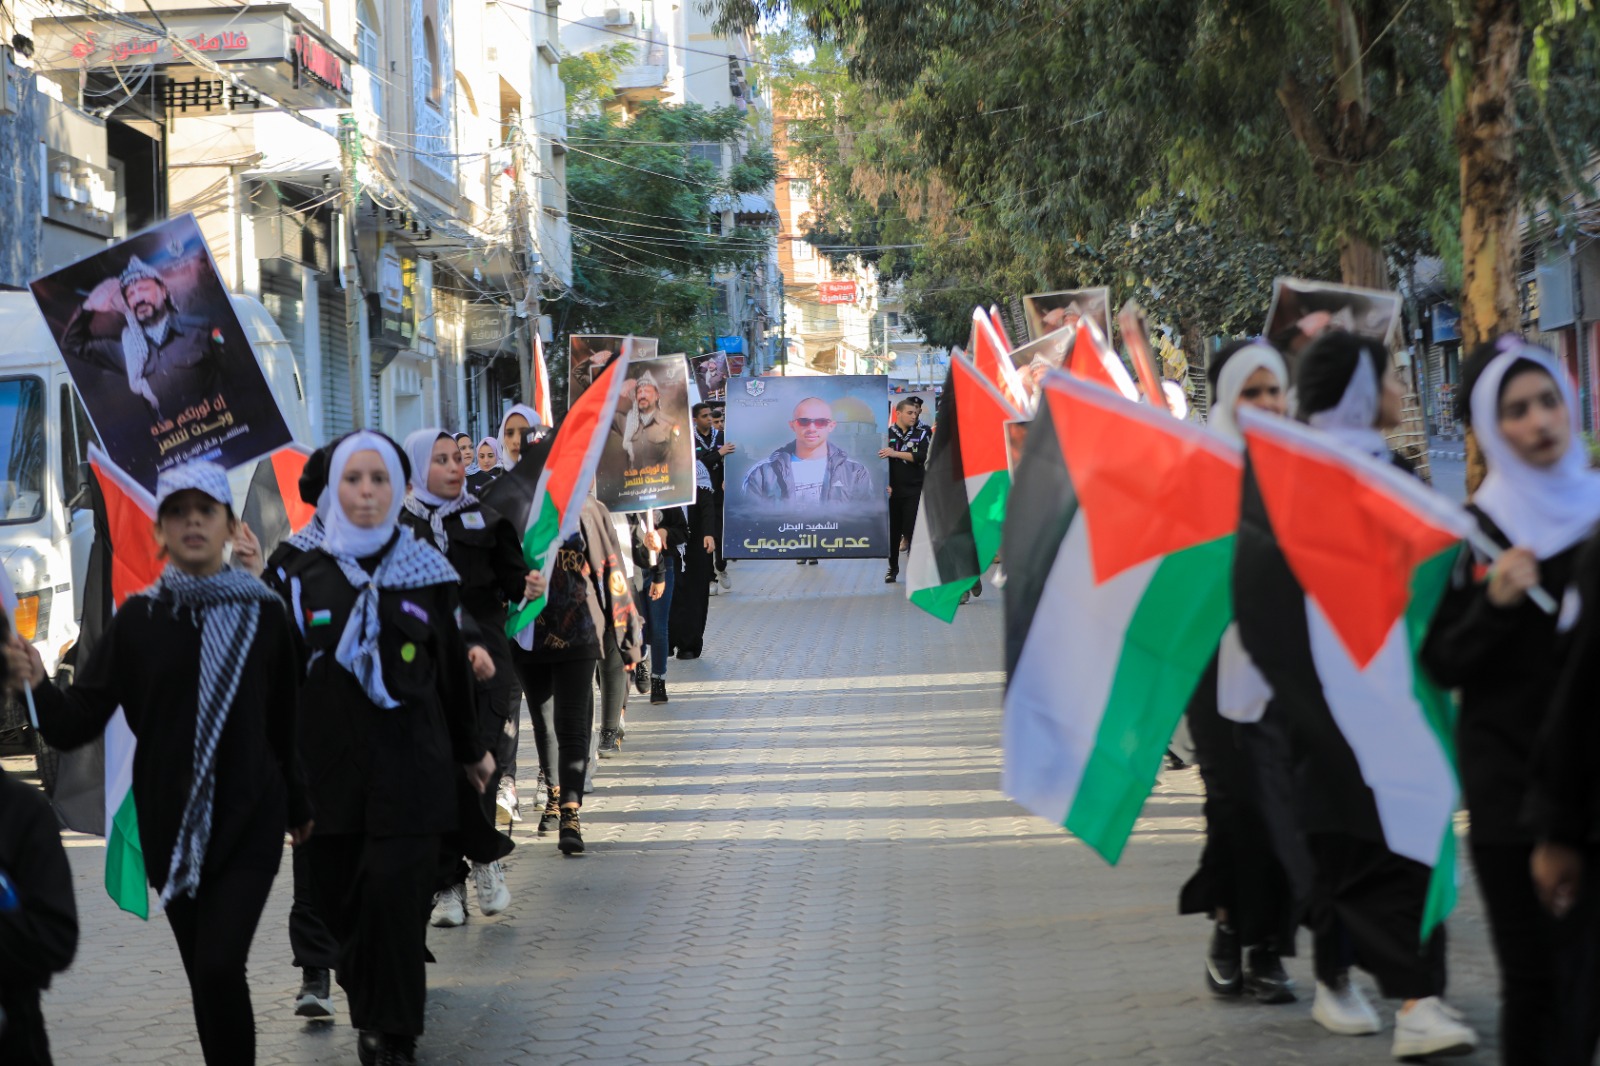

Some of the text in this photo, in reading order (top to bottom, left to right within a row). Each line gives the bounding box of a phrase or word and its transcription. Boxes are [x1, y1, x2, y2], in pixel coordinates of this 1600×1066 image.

[778, 521, 838, 532] الشهيد البطل
[743, 533, 870, 552] عدي التميمي
